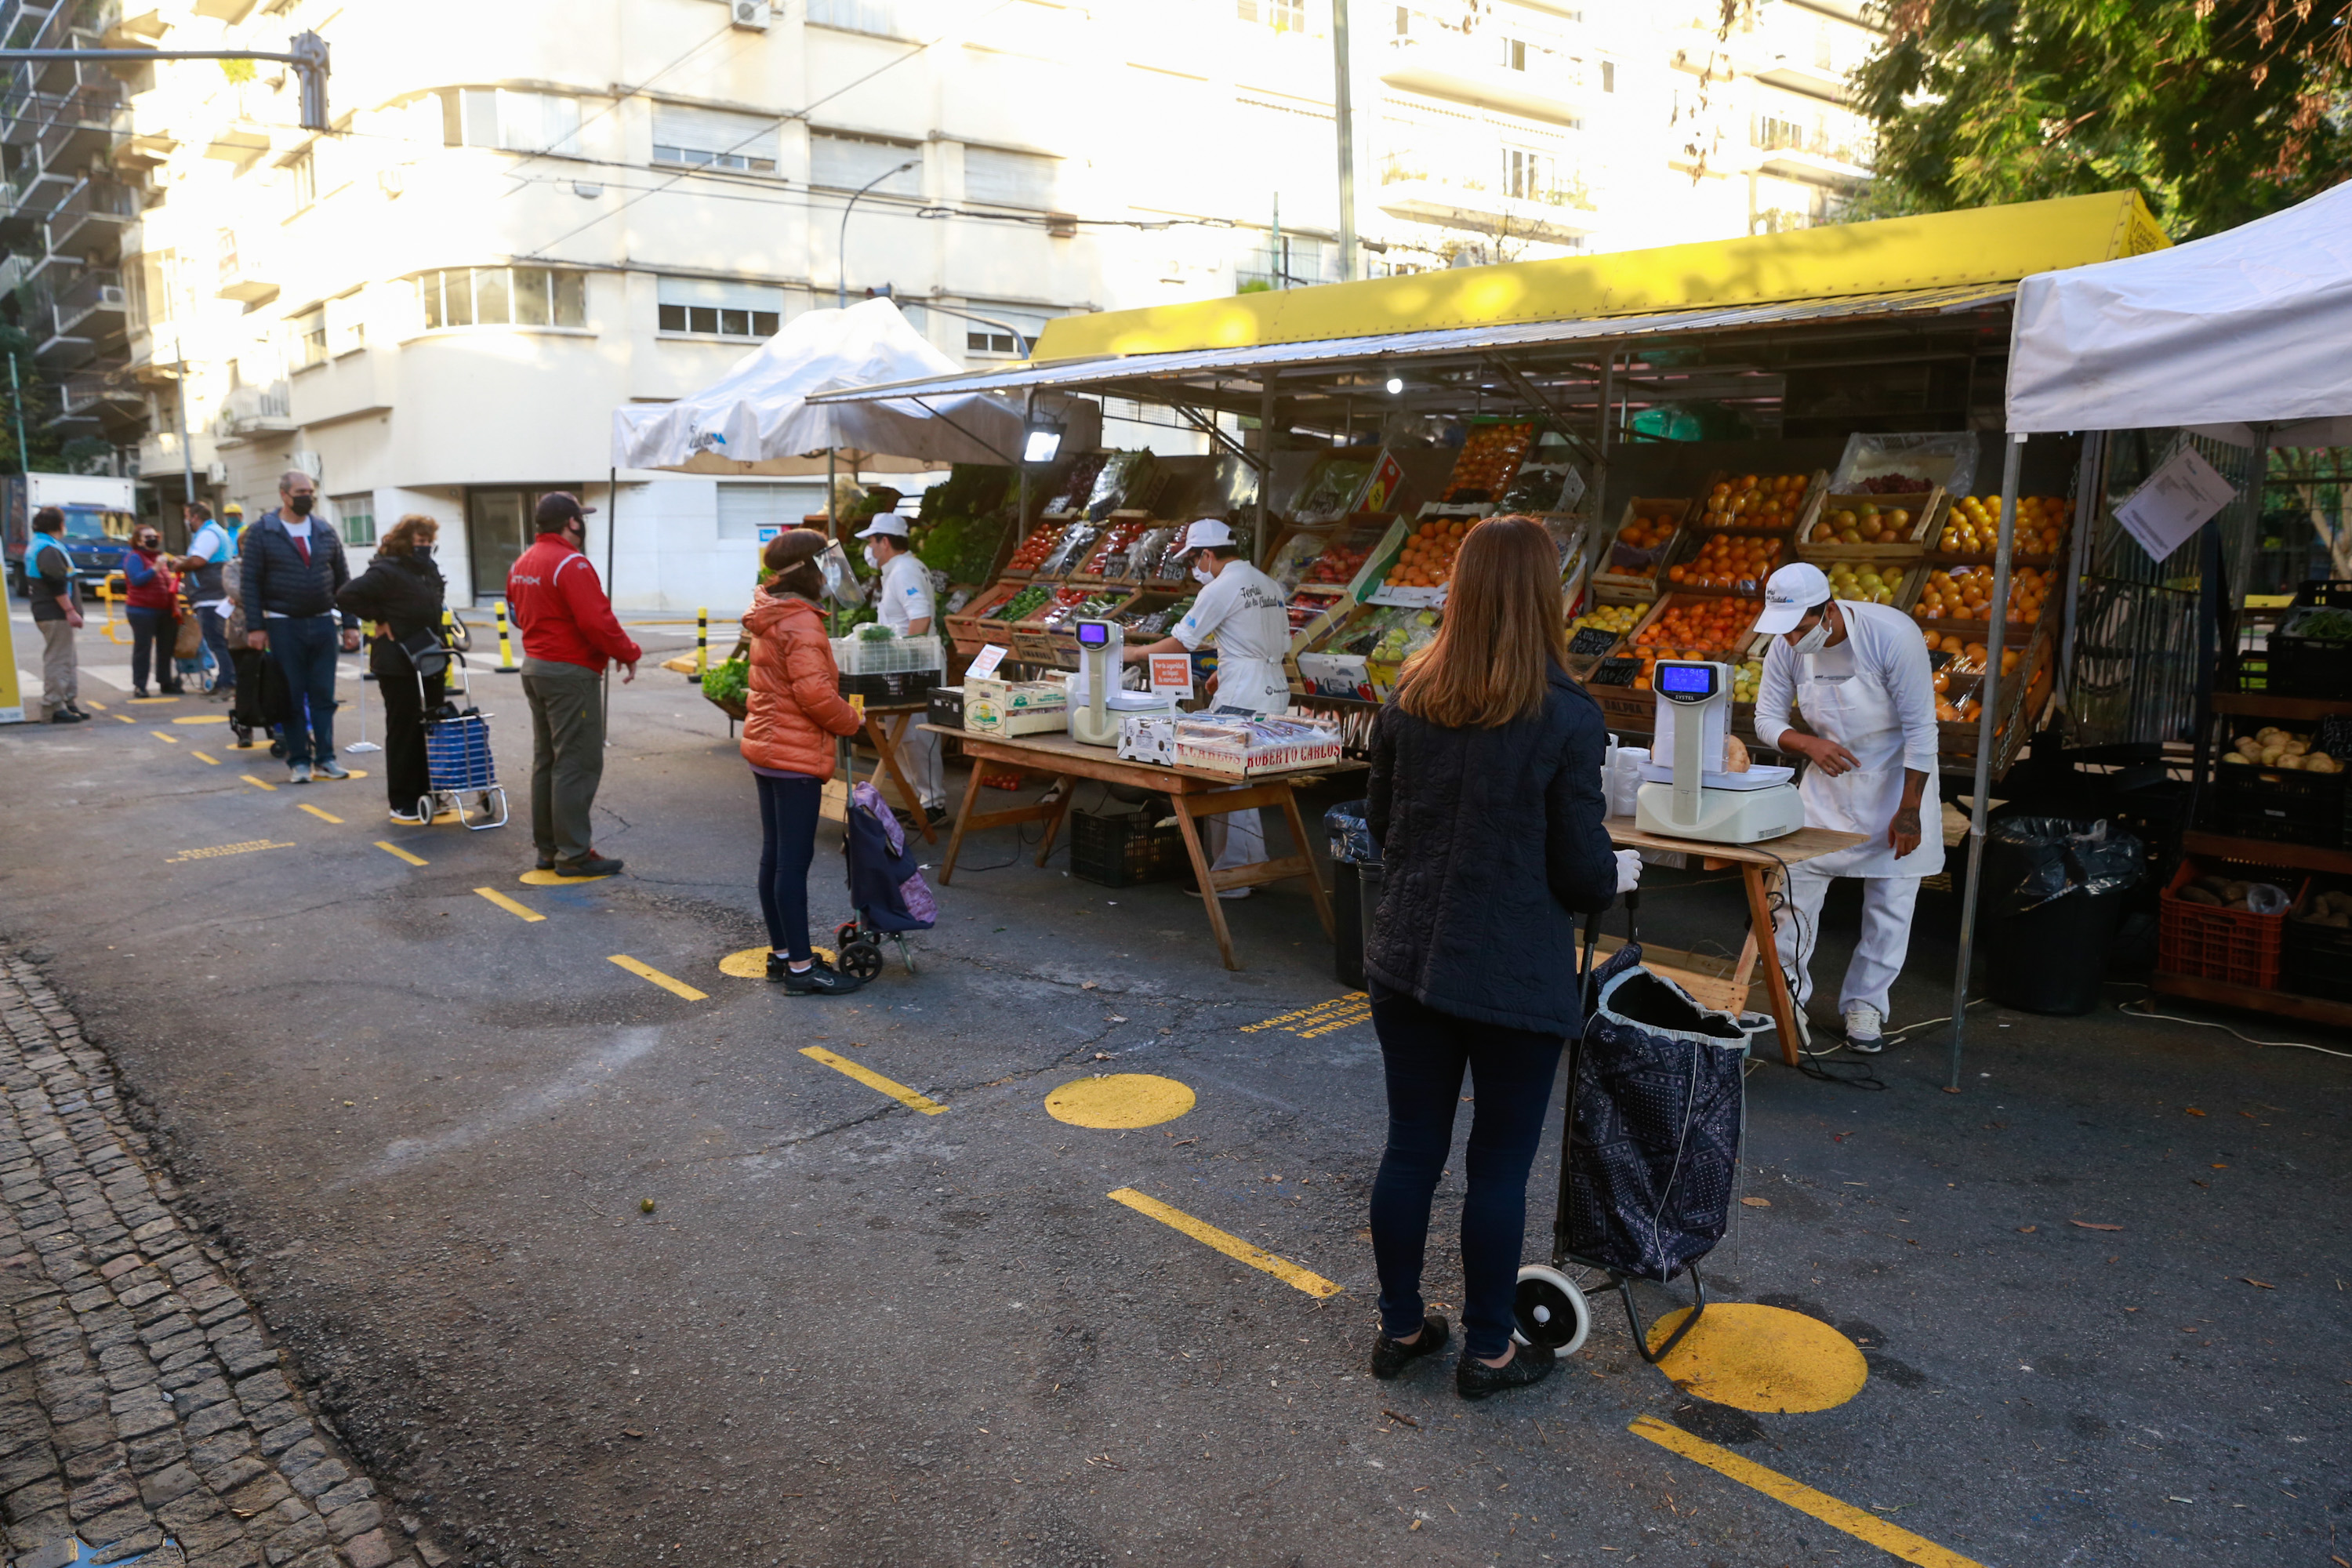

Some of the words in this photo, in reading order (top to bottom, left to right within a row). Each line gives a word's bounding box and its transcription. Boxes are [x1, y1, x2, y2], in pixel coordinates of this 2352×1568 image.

[1240, 584, 1261, 598] Ferias
[1259, 595, 1277, 608] Ciudad
[1247, 746, 1298, 768] ROBERTO
[1301, 742, 1342, 760] CARLOS
